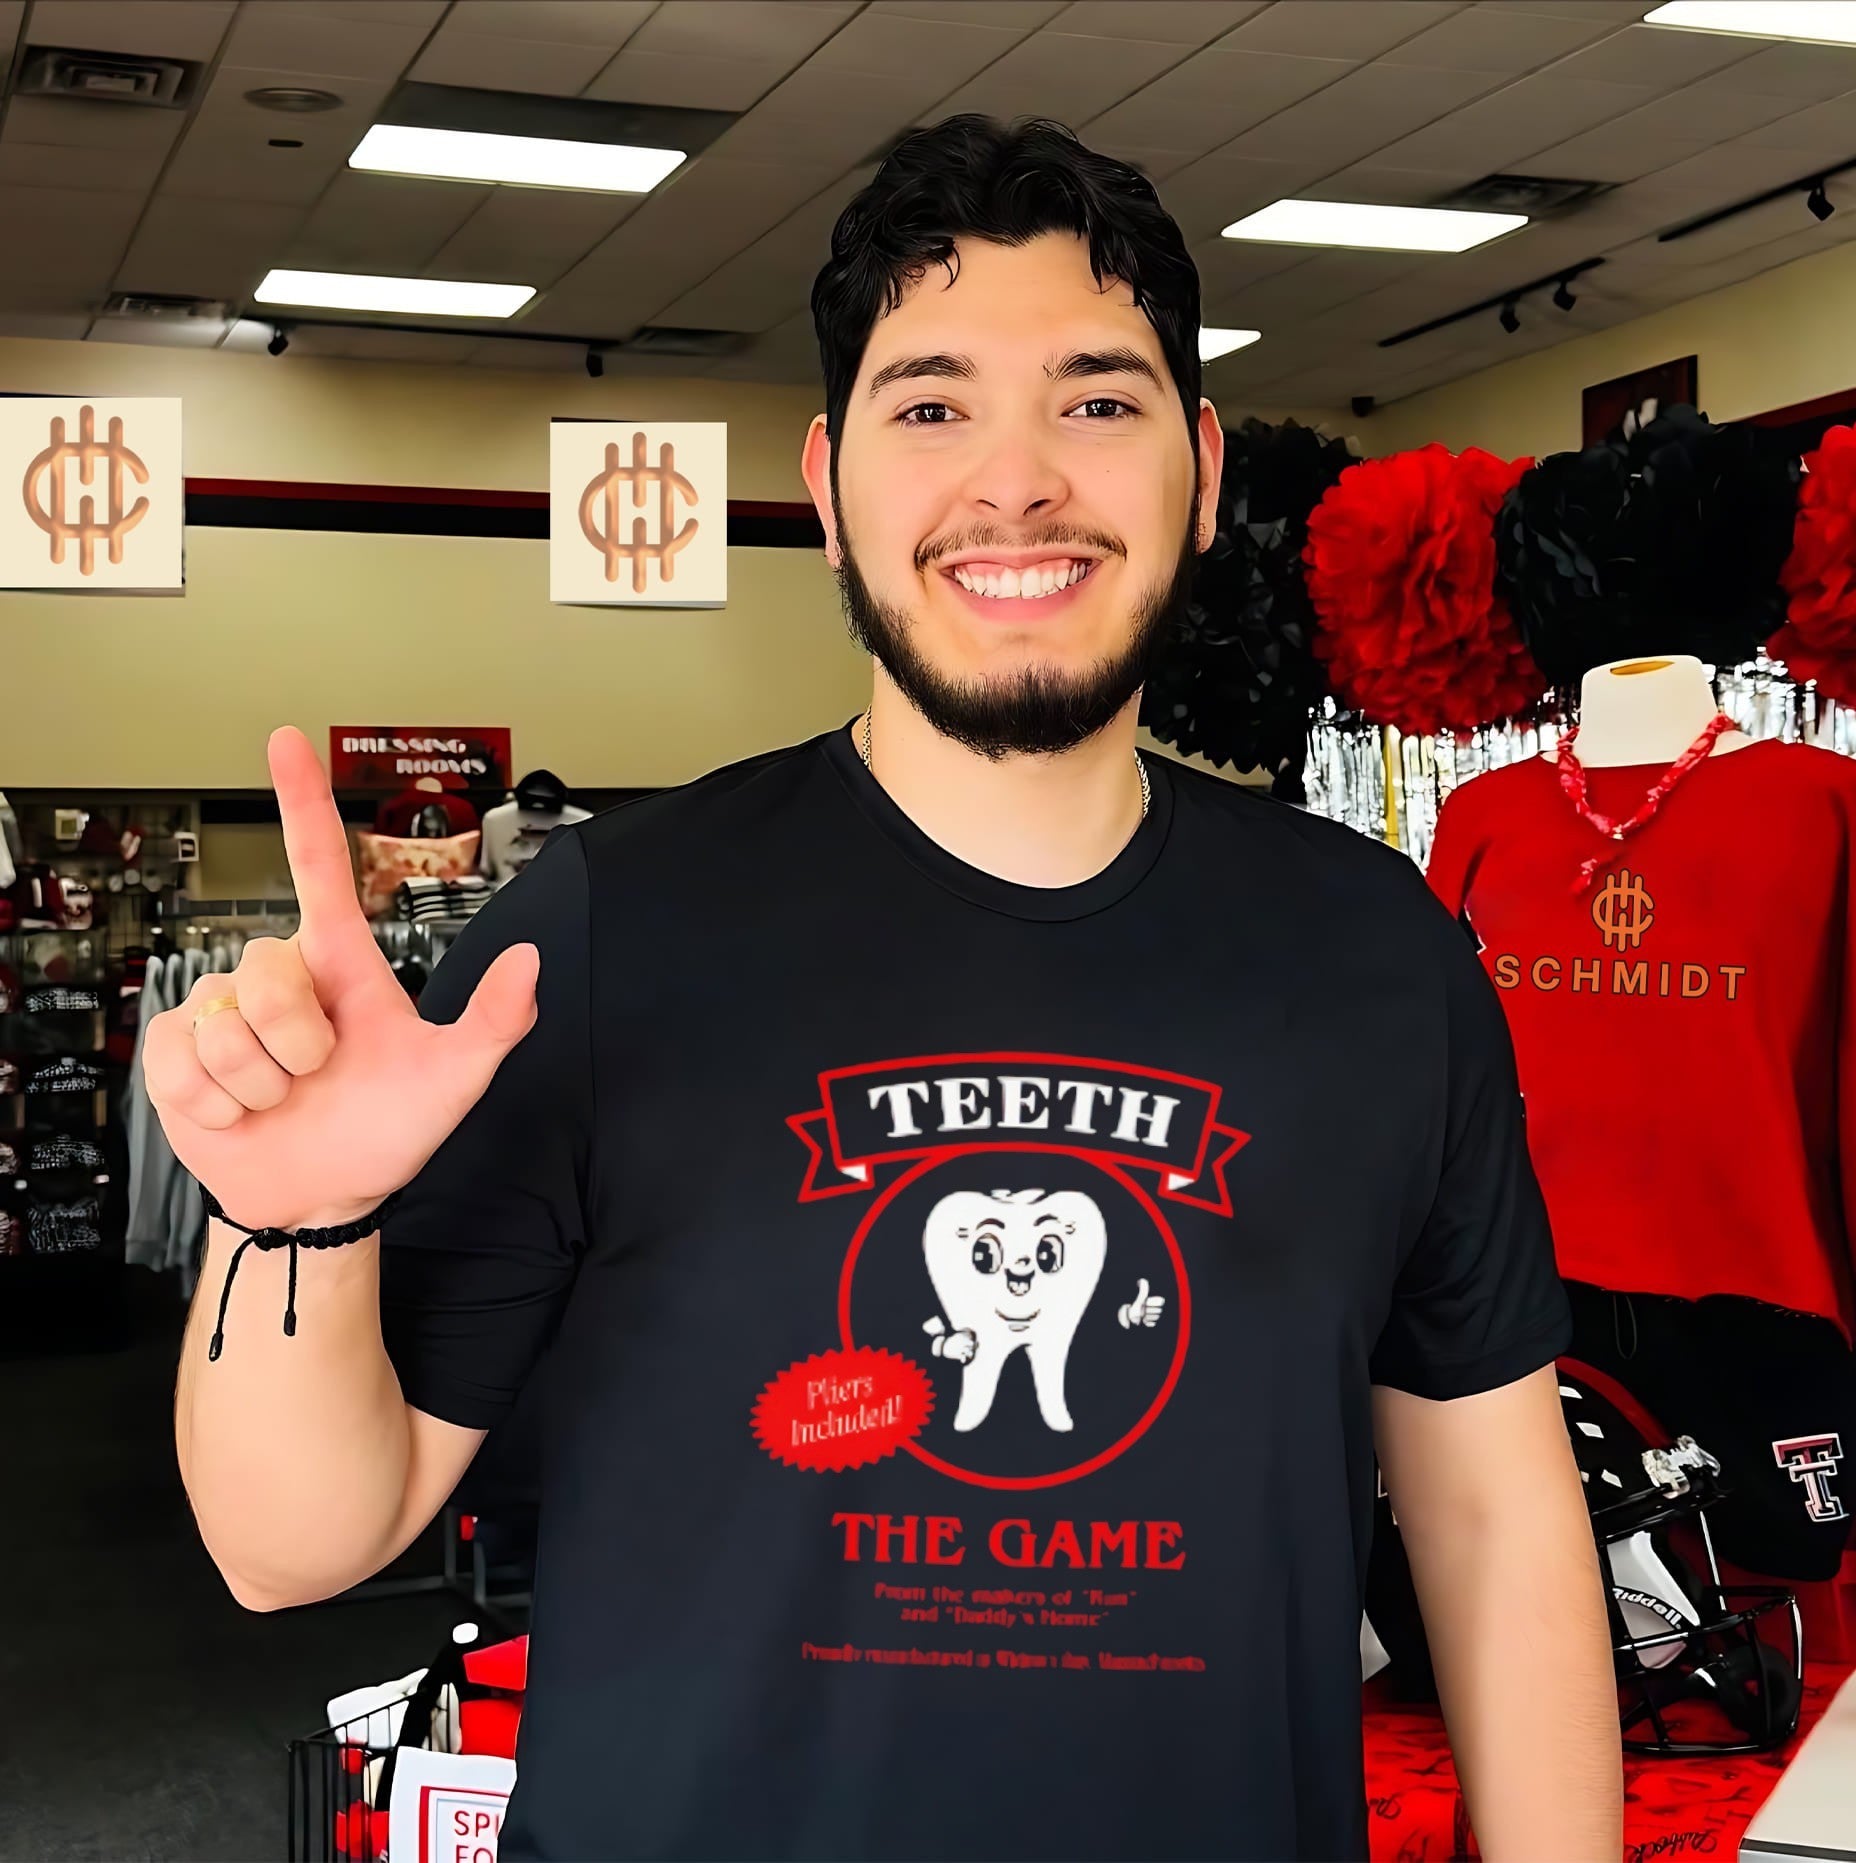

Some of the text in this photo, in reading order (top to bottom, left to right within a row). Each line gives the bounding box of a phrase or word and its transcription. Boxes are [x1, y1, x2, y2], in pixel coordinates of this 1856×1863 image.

[342, 738, 466, 753] DRESSING
[396, 758, 487, 775] ROOMS
[1494, 953, 1747, 1001] SCHMIDT
[867, 1075, 1181, 1148] TEETH
[807, 1376, 873, 1410] Pliers
[832, 1512, 1186, 1571] THE GAME
[901, 1605, 939, 1623] and
